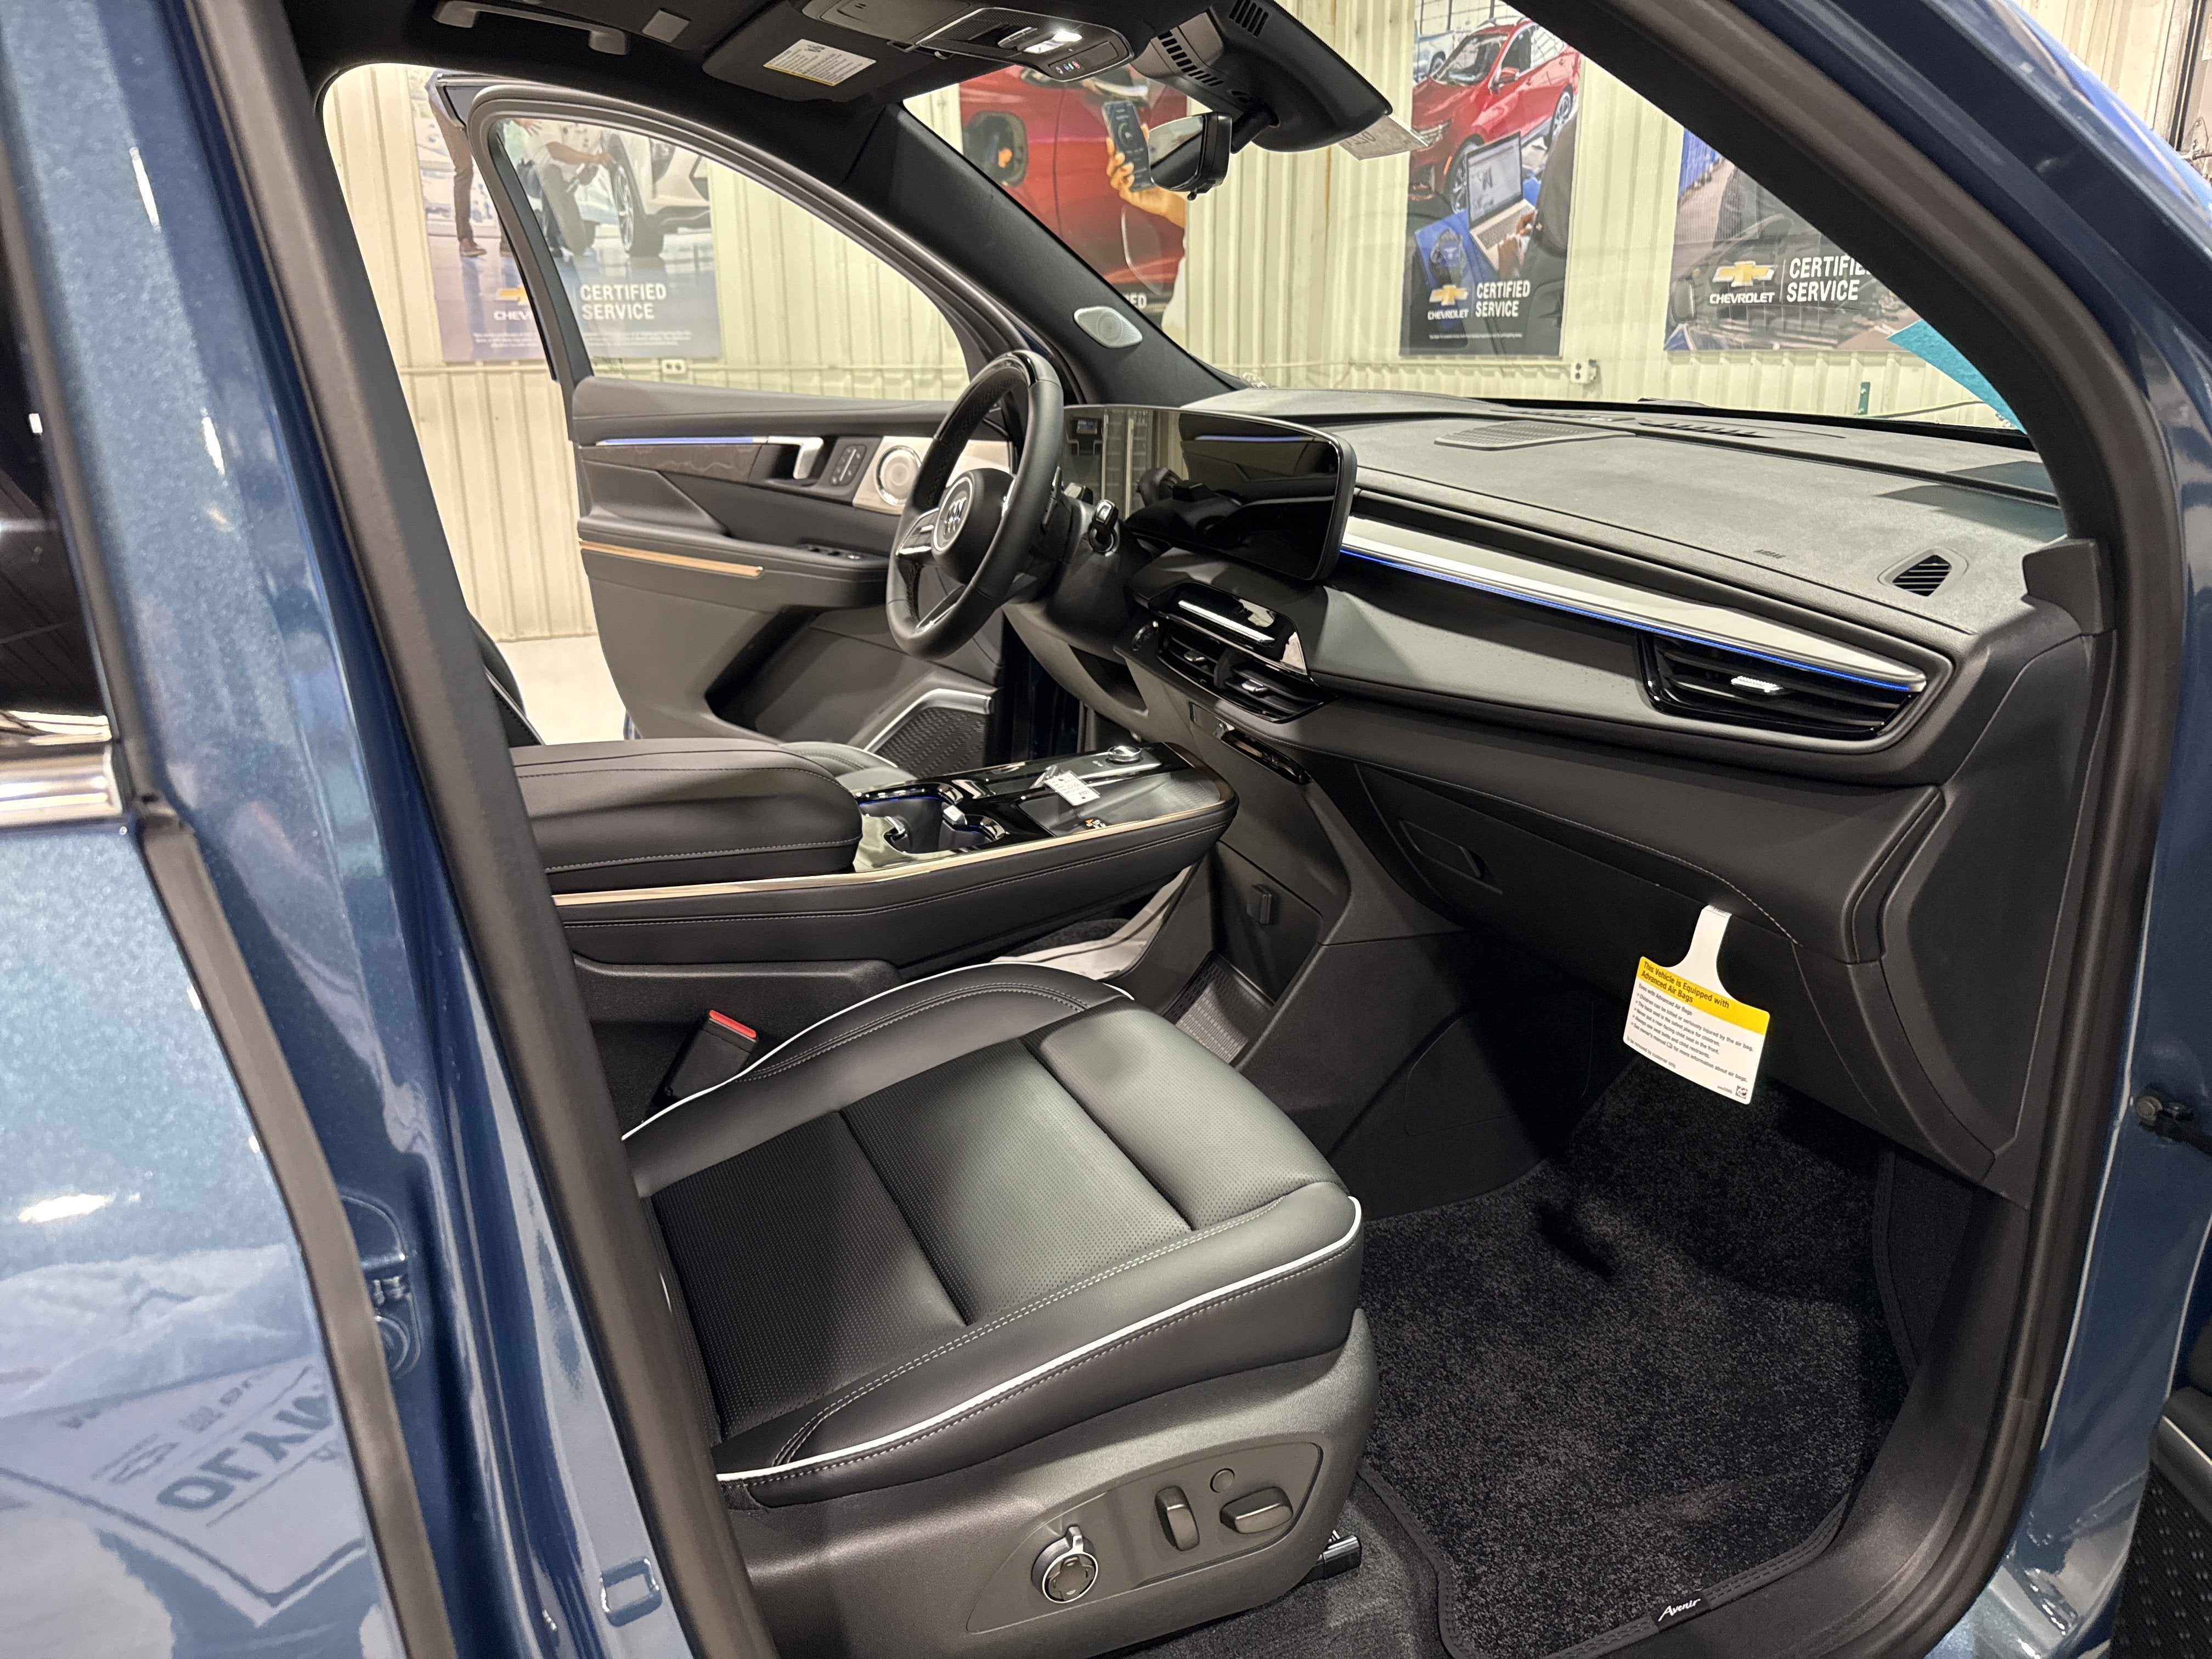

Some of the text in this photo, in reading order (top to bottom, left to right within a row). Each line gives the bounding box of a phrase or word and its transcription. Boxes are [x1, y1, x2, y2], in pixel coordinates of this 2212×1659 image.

[1790, 255, 1871, 278] CERTIFIE
[580, 283, 667, 301] CERTIFIED
[1476, 280, 1531, 299] CERTIFIED
[1709, 291, 1775, 304] CHEVROLET
[1786, 279, 1860, 302] SERVICE
[582, 303, 656, 320] SERVICE
[1427, 308, 1469, 320] CHEVROLET
[1475, 300, 1519, 318] SERVICE
[1641, 970, 1693, 1002] Advanced Air Bags
[1644, 961, 1654, 973] This
[1656, 968, 1674, 984] Vehicle
[1683, 983, 1712, 1001] Equipped
[1714, 997, 1729, 1008] with
[1656, 994, 1674, 1006] Advanced
[1681, 1007, 1692, 1015] Bags
[1667, 1009, 1678, 1018] killed
[1703, 1027, 1718, 1037] injured
[1715, 1066, 1727, 1074] about
[1658, 1599, 1701, 1622] Avenir
